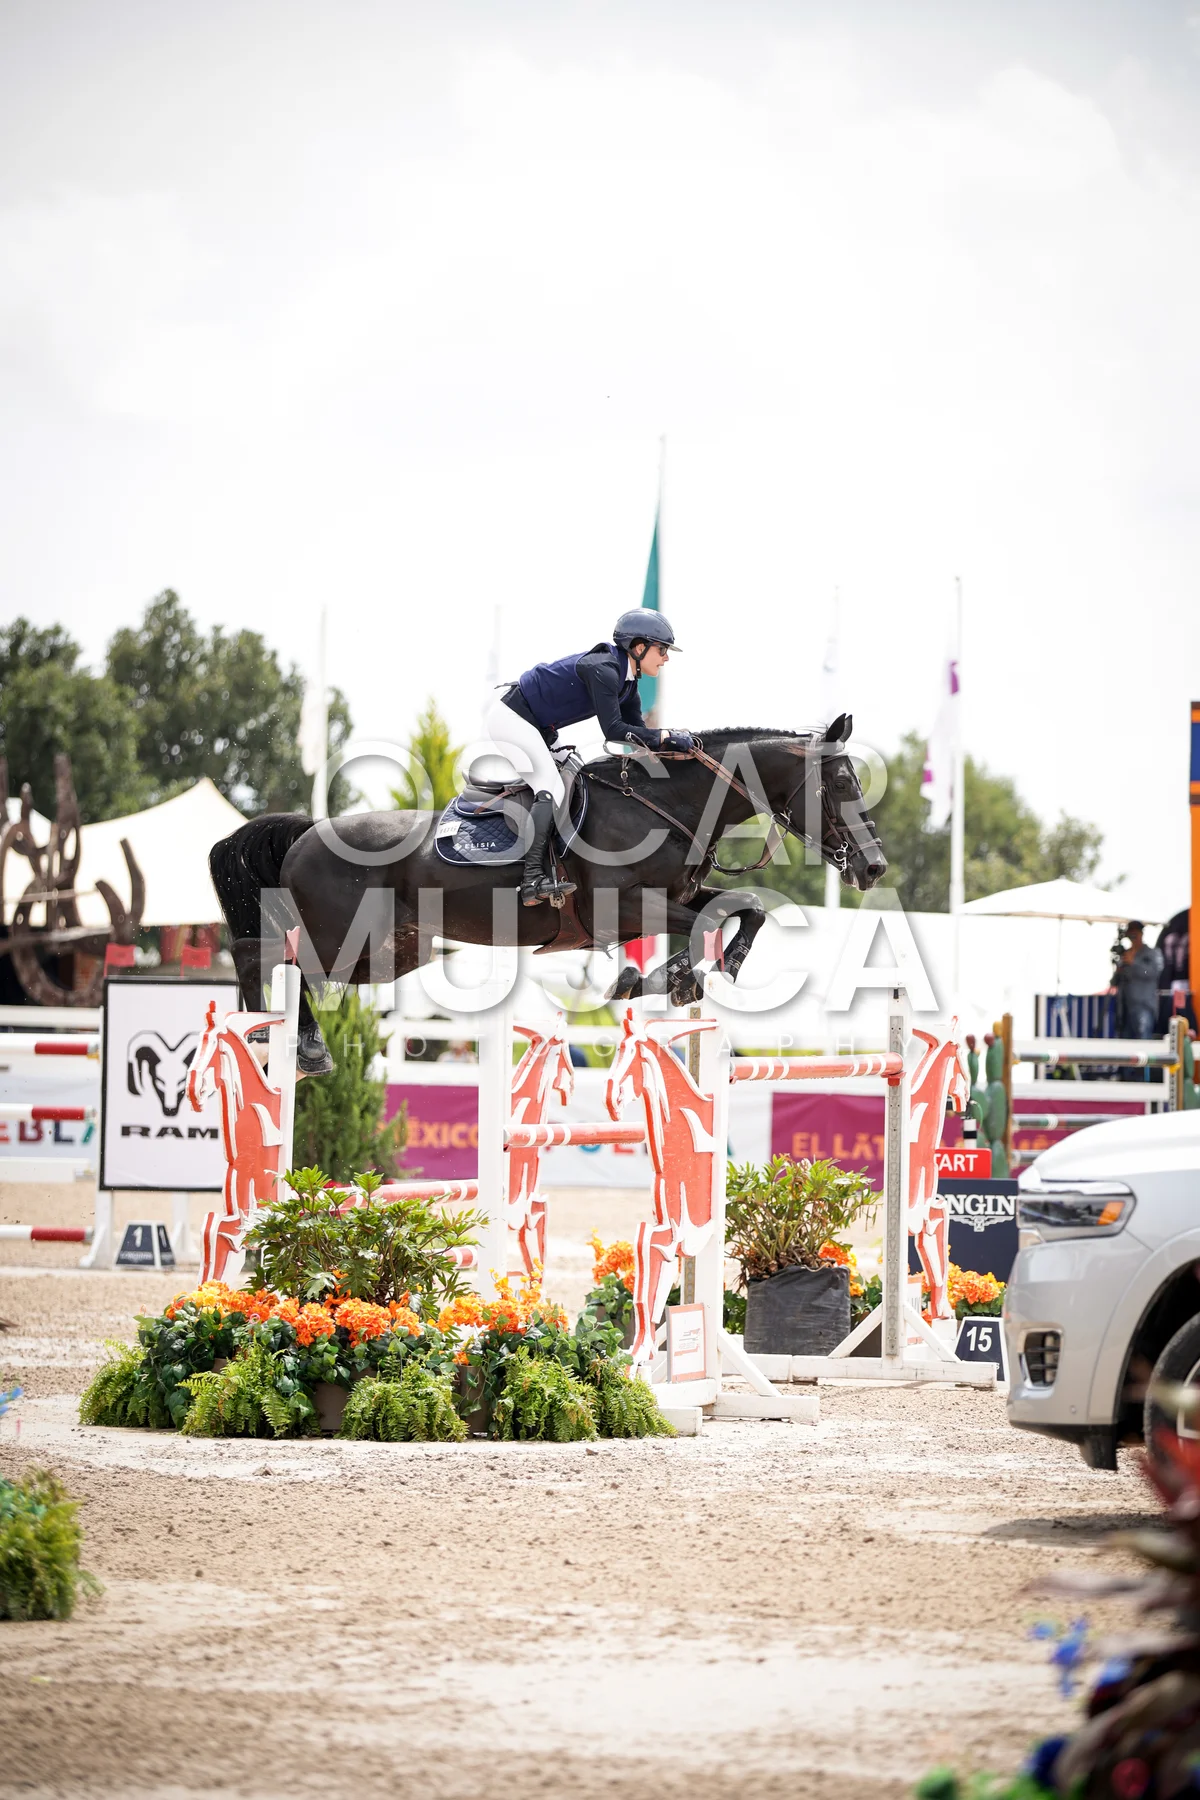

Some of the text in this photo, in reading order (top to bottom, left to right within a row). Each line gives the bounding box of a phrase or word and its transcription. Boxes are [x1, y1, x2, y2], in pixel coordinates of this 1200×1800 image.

[121, 1125, 219, 1139] RAM
[792, 1131, 826, 1158] EL
[131, 1226, 143, 1248] 1
[966, 1326, 993, 1352] 15
